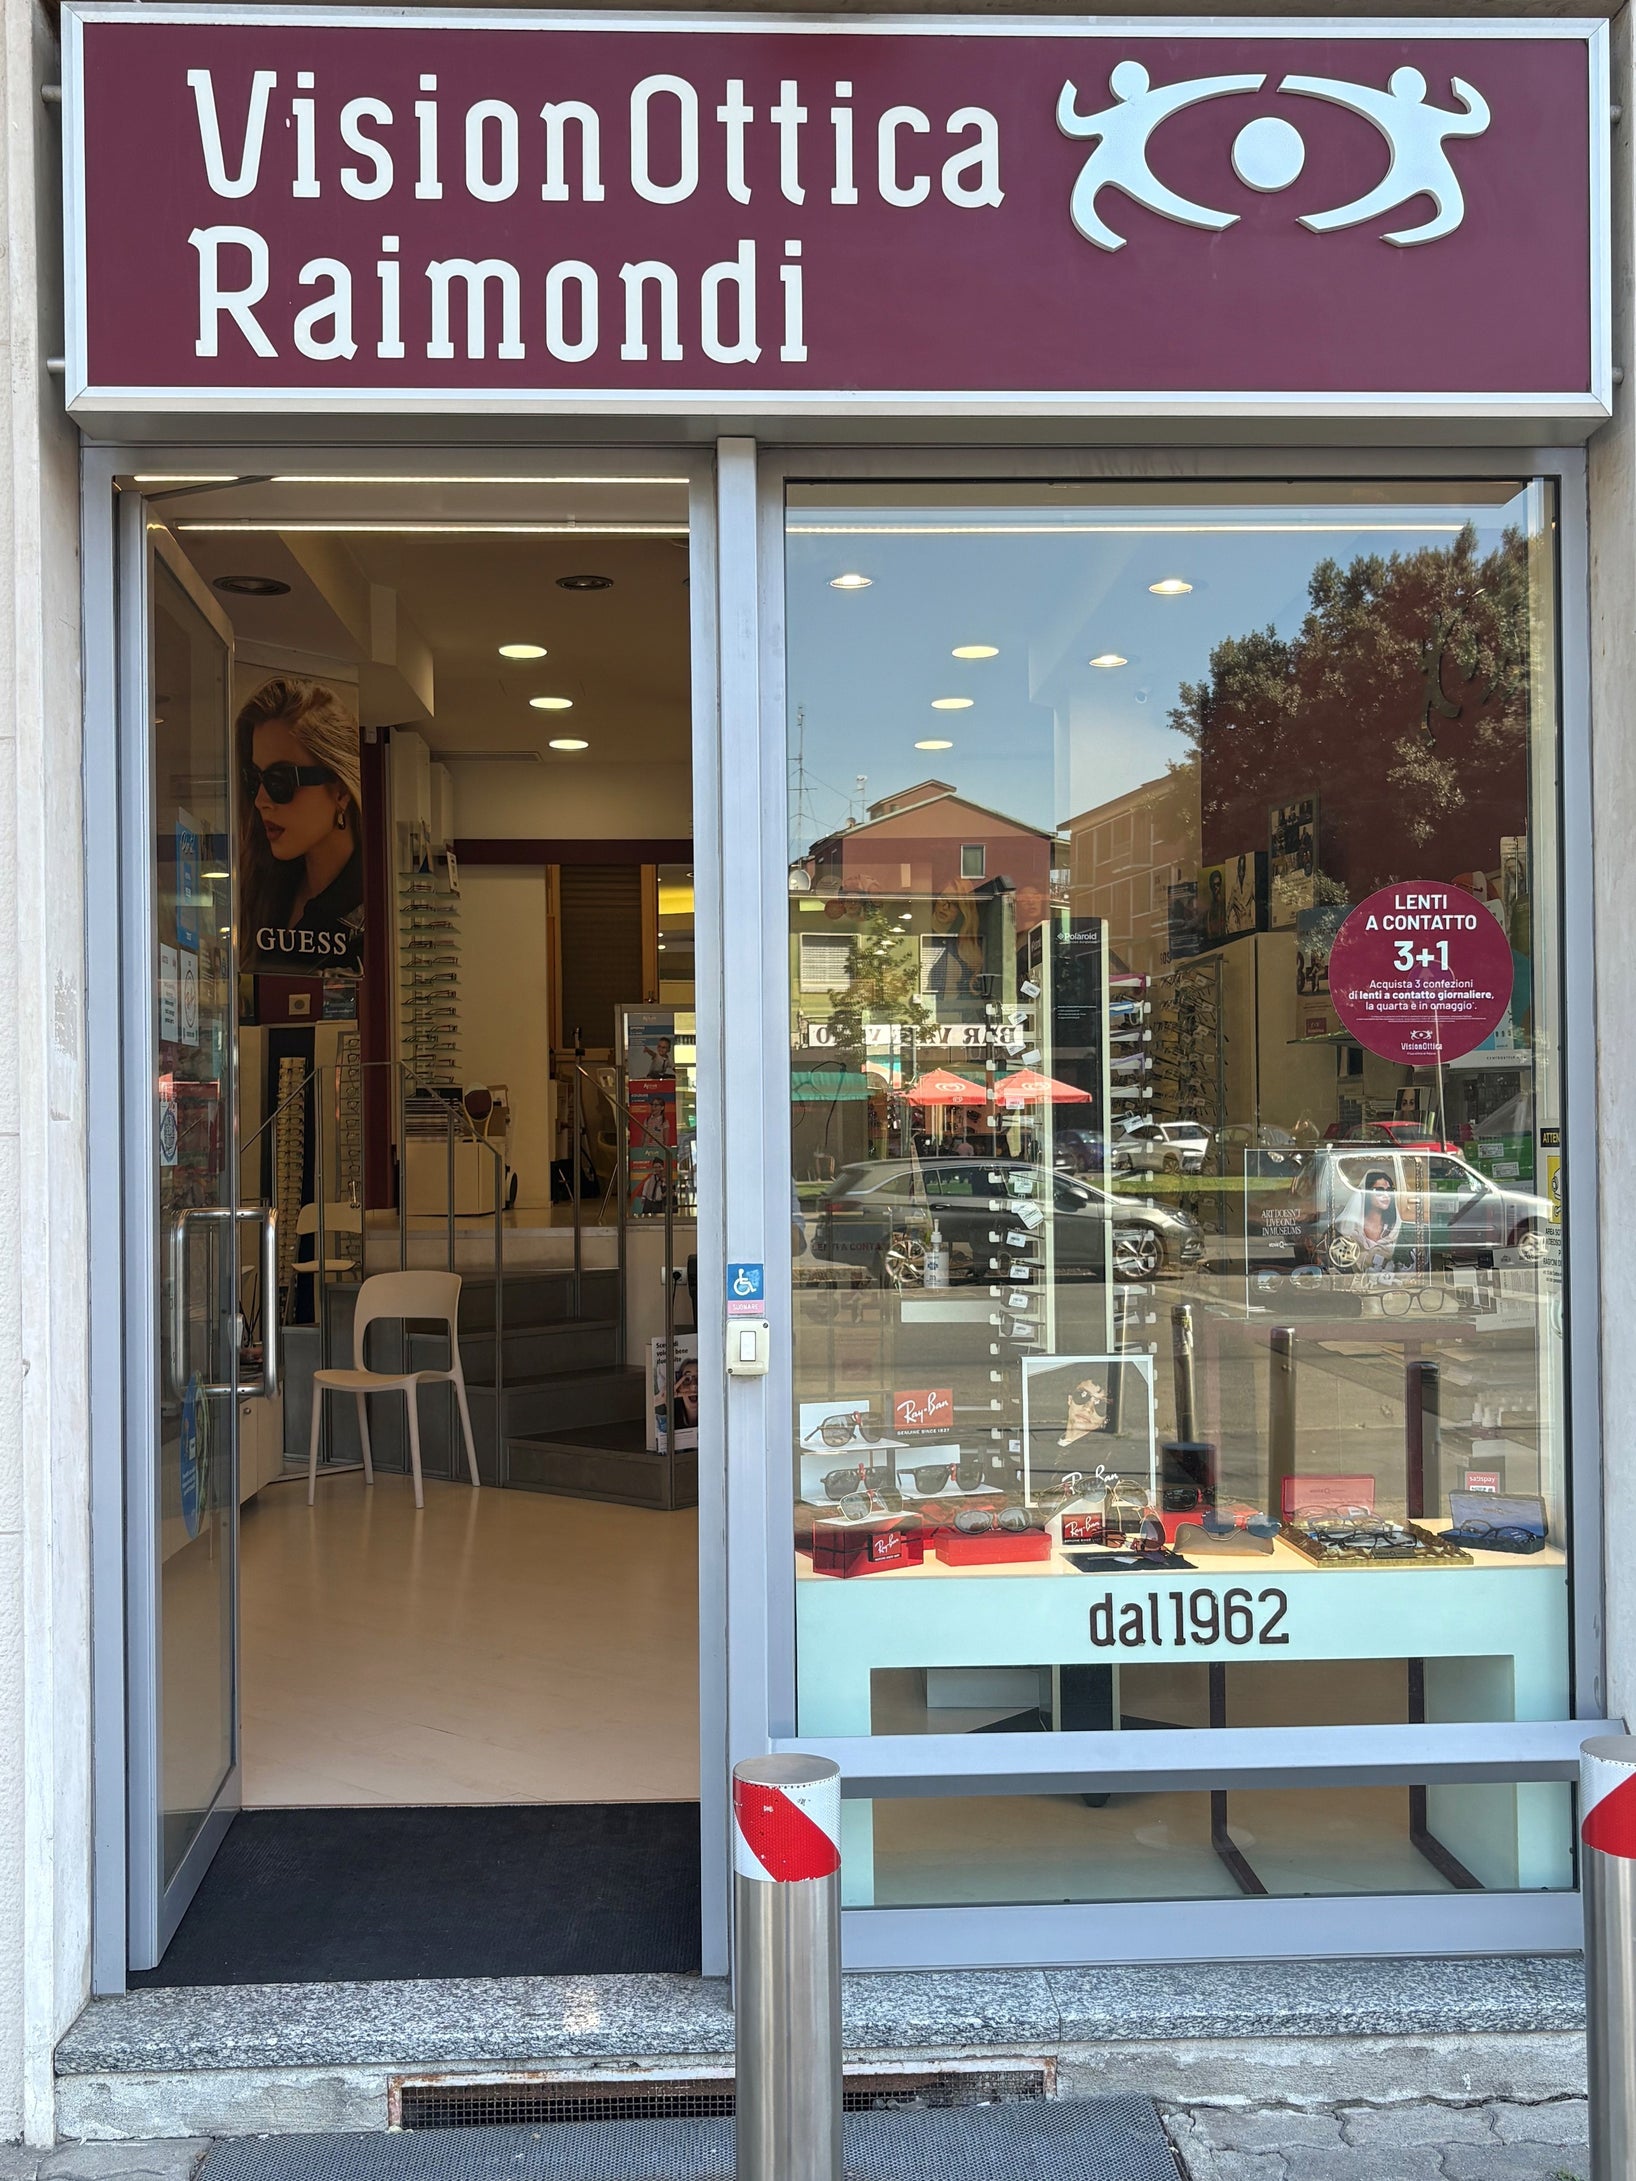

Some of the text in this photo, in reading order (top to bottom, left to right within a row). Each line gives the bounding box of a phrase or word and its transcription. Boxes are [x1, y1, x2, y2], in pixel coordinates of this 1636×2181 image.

[187, 68, 1006, 209] VisionOttica
[187, 224, 810, 364] Raimondi
[1395, 894, 1448, 910] LENTI
[1365, 914, 1478, 931] A CONTATTO
[256, 927, 347, 956] GUESS
[1064, 932, 1098, 941] Polaroid
[1393, 940, 1450, 972] 3+1
[1369, 979, 1473, 991] Acquista 3 confezioni
[1348, 990, 1494, 1001] di lenti a contatto giornaliere,
[1365, 1001, 1374, 1010] la
[1376, 1002, 1409, 1012] quarta
[1410, 1001, 1417, 1010] è
[1419, 1001, 1428, 1010] in
[1400, 1042, 1443, 1051] VisionOttica
[896, 1391, 949, 1424] Ray-Ban
[1064, 1515, 1101, 1537] Ray-Ban
[874, 1533, 900, 1554] Ray-Ban
